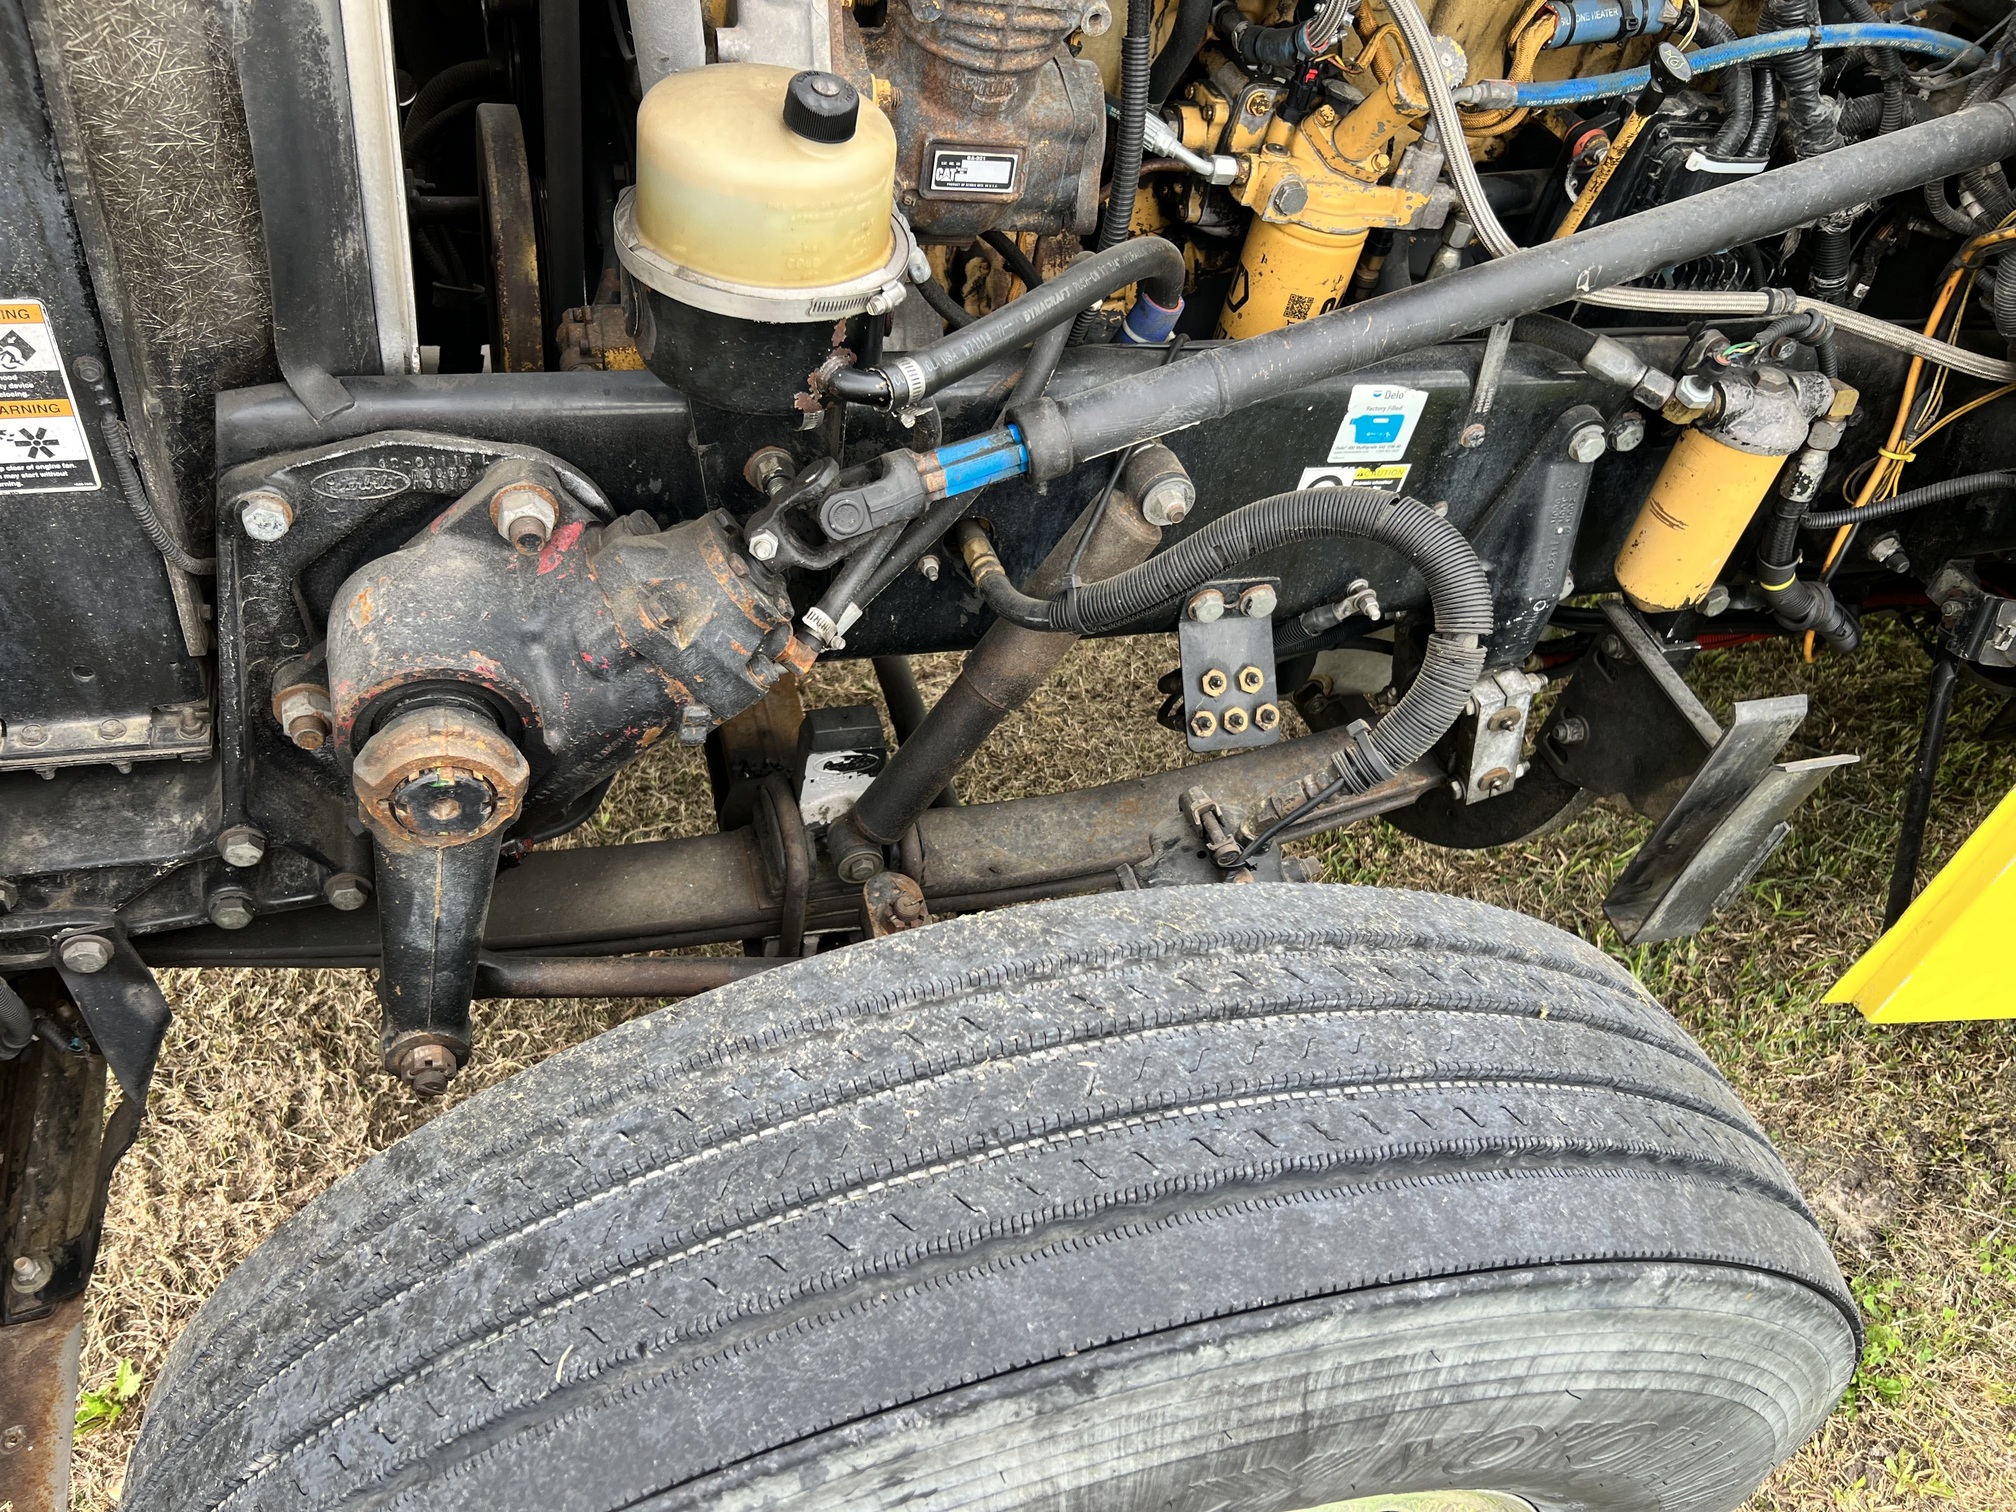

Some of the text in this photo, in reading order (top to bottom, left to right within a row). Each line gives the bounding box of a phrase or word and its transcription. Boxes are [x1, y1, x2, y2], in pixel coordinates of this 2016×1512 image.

[1561, 8, 1619, 25] SILONE HEATER
[936, 167, 956, 182] CAT
[941, 349, 959, 365] USA
[1023, 287, 1071, 322] DYNACRAFT
[1384, 390, 1404, 399] Delo
